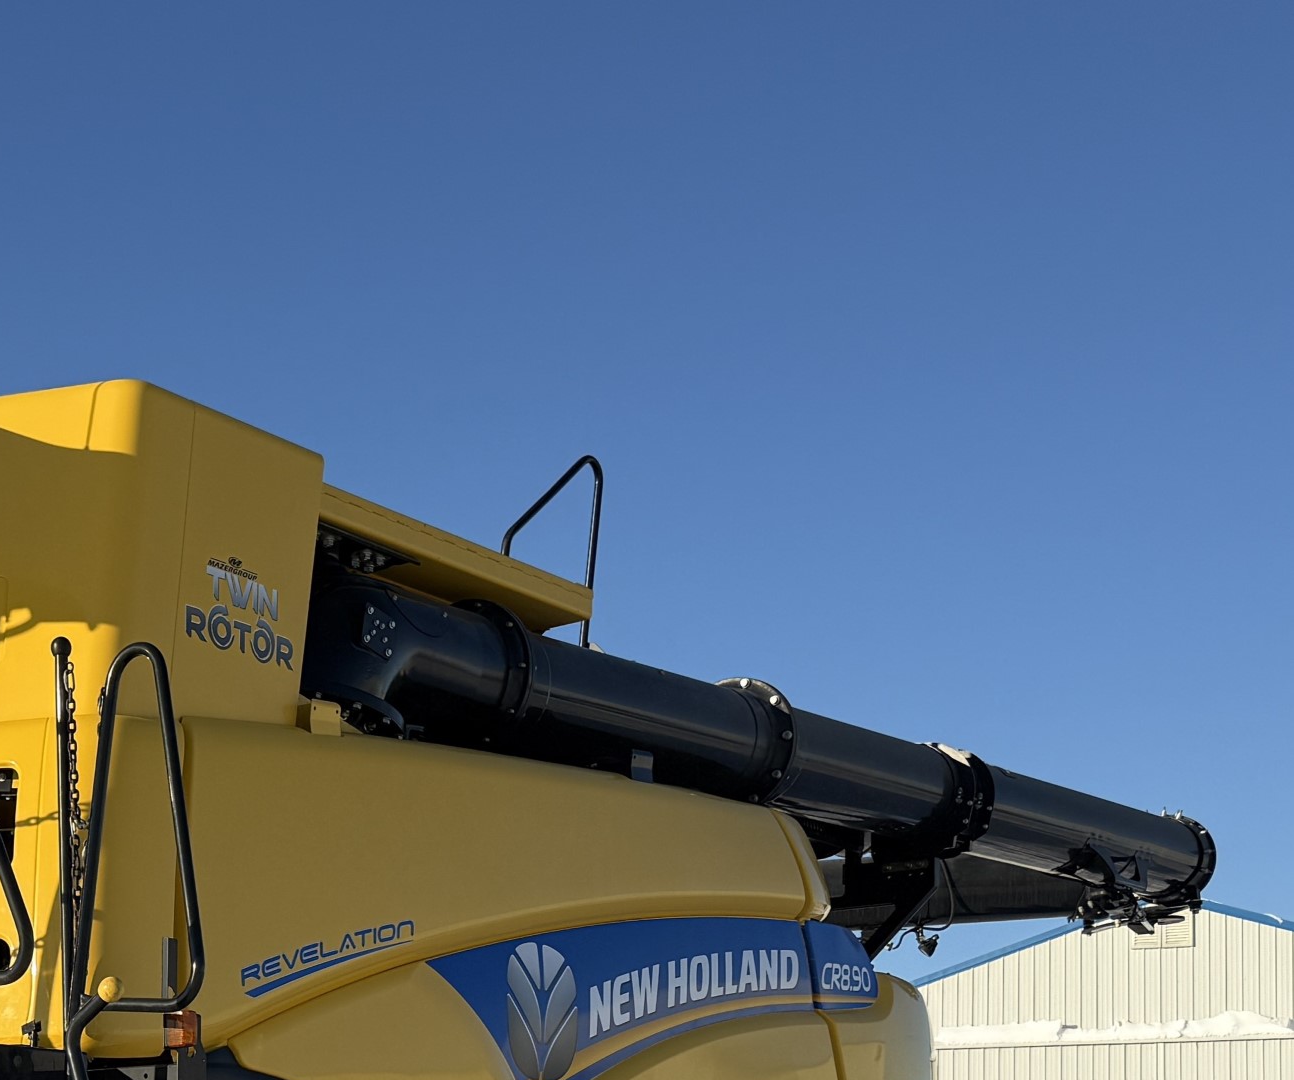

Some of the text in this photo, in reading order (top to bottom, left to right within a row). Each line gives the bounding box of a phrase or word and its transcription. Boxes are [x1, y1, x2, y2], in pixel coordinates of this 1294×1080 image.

[206, 565, 279, 622] TWIN
[207, 559, 258, 582] MAZERGROUP
[186, 603, 294, 672] ROTOR
[241, 920, 414, 987] REVELATION
[821, 962, 871, 993] CR8.90
[589, 949, 799, 1039] NEW HOLLAND
